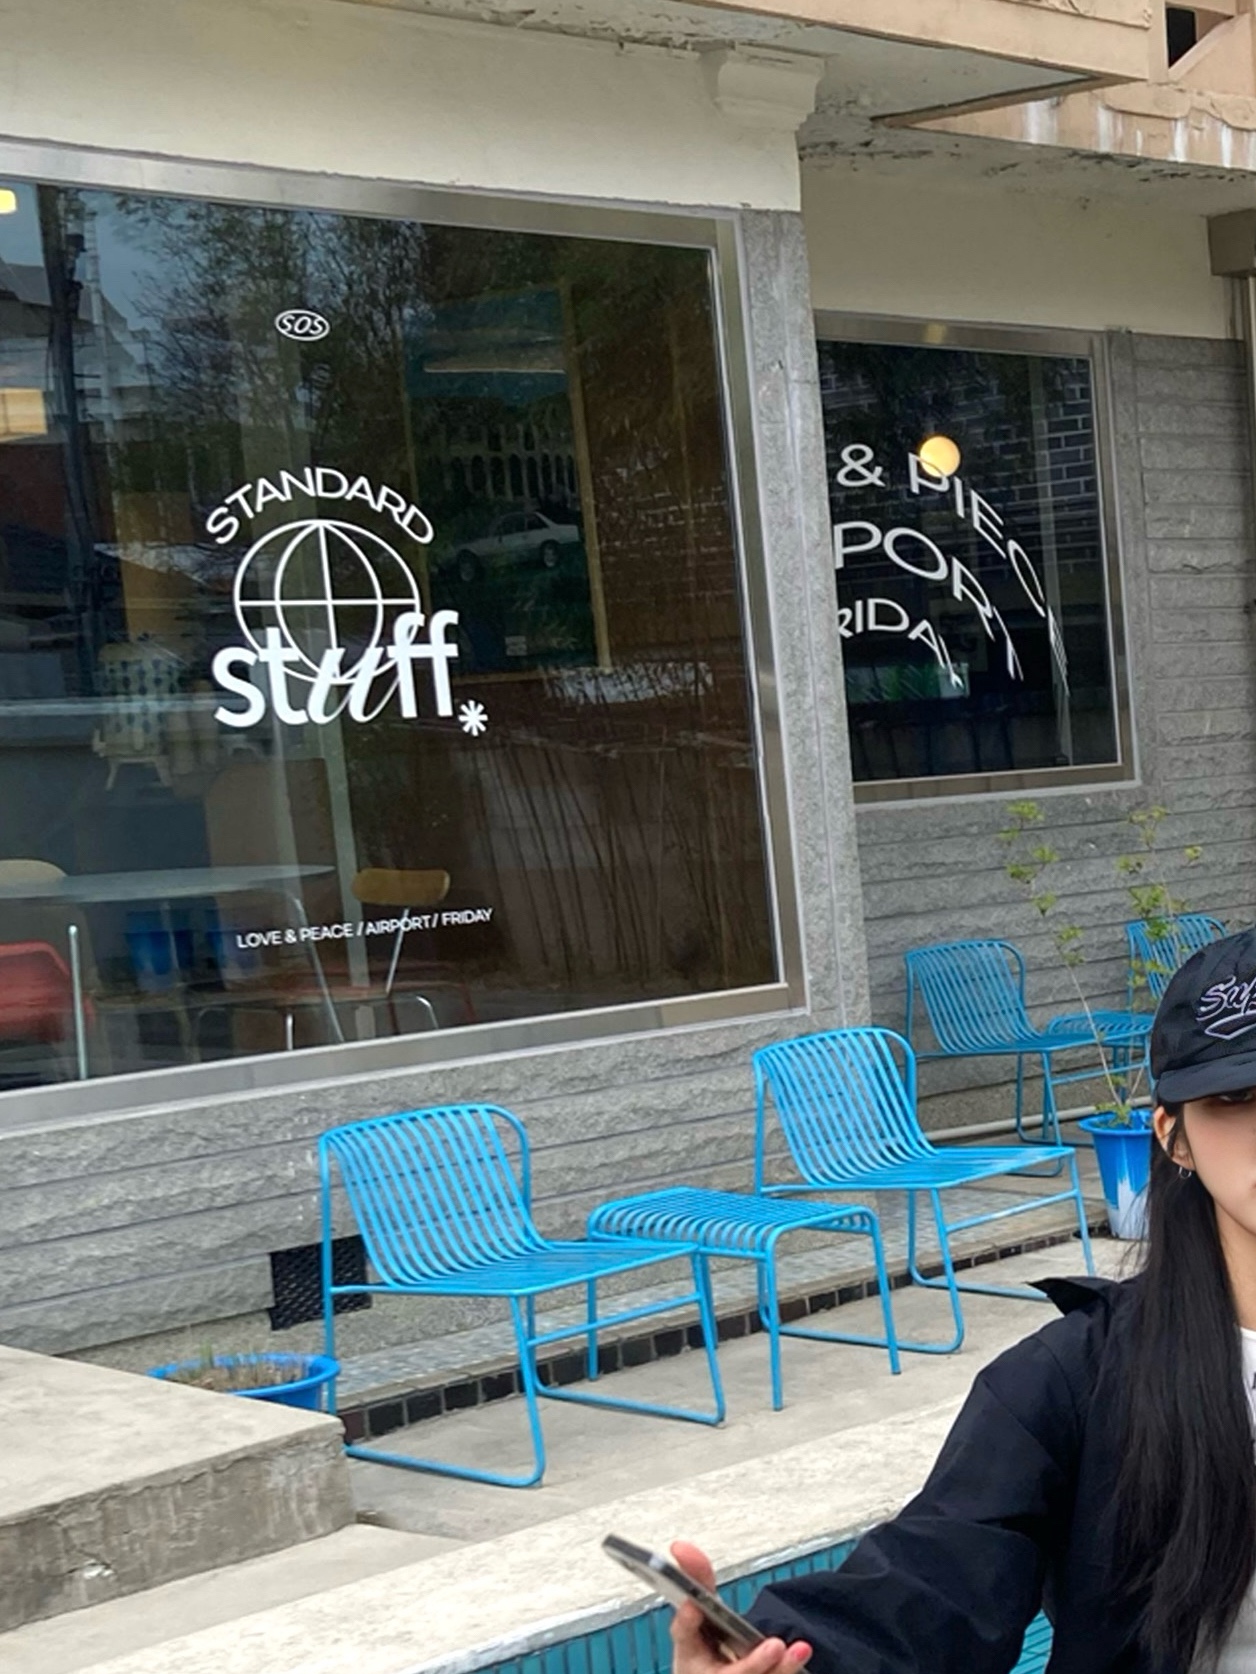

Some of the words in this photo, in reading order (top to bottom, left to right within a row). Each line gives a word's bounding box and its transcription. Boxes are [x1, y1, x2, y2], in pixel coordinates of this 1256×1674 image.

[280, 313, 324, 334] SOS
[836, 443, 886, 488] &
[206, 467, 434, 544] STANDARD
[236, 930, 283, 948] LOVE
[284, 929, 298, 944] &
[299, 922, 354, 941] PEACE
[365, 914, 431, 936] AIRPORT
[441, 908, 494, 926] FRIDAY
